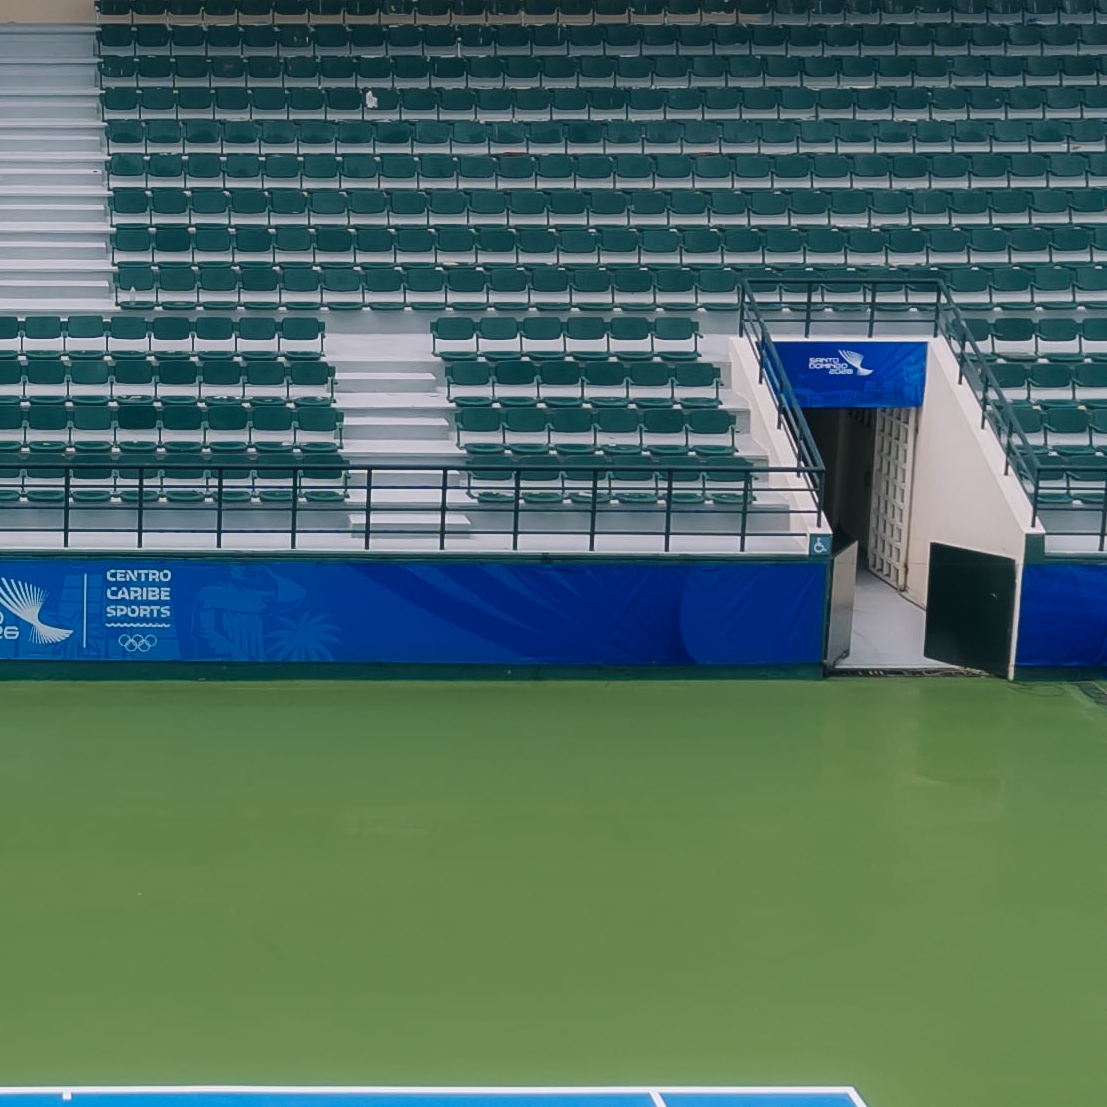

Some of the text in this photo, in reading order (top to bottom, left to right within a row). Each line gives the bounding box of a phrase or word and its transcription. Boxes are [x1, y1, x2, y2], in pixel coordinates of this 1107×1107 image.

[106, 569, 172, 582] CENTRO
[106, 587, 171, 601] CARIBE
[106, 605, 171, 618] SPORTS
